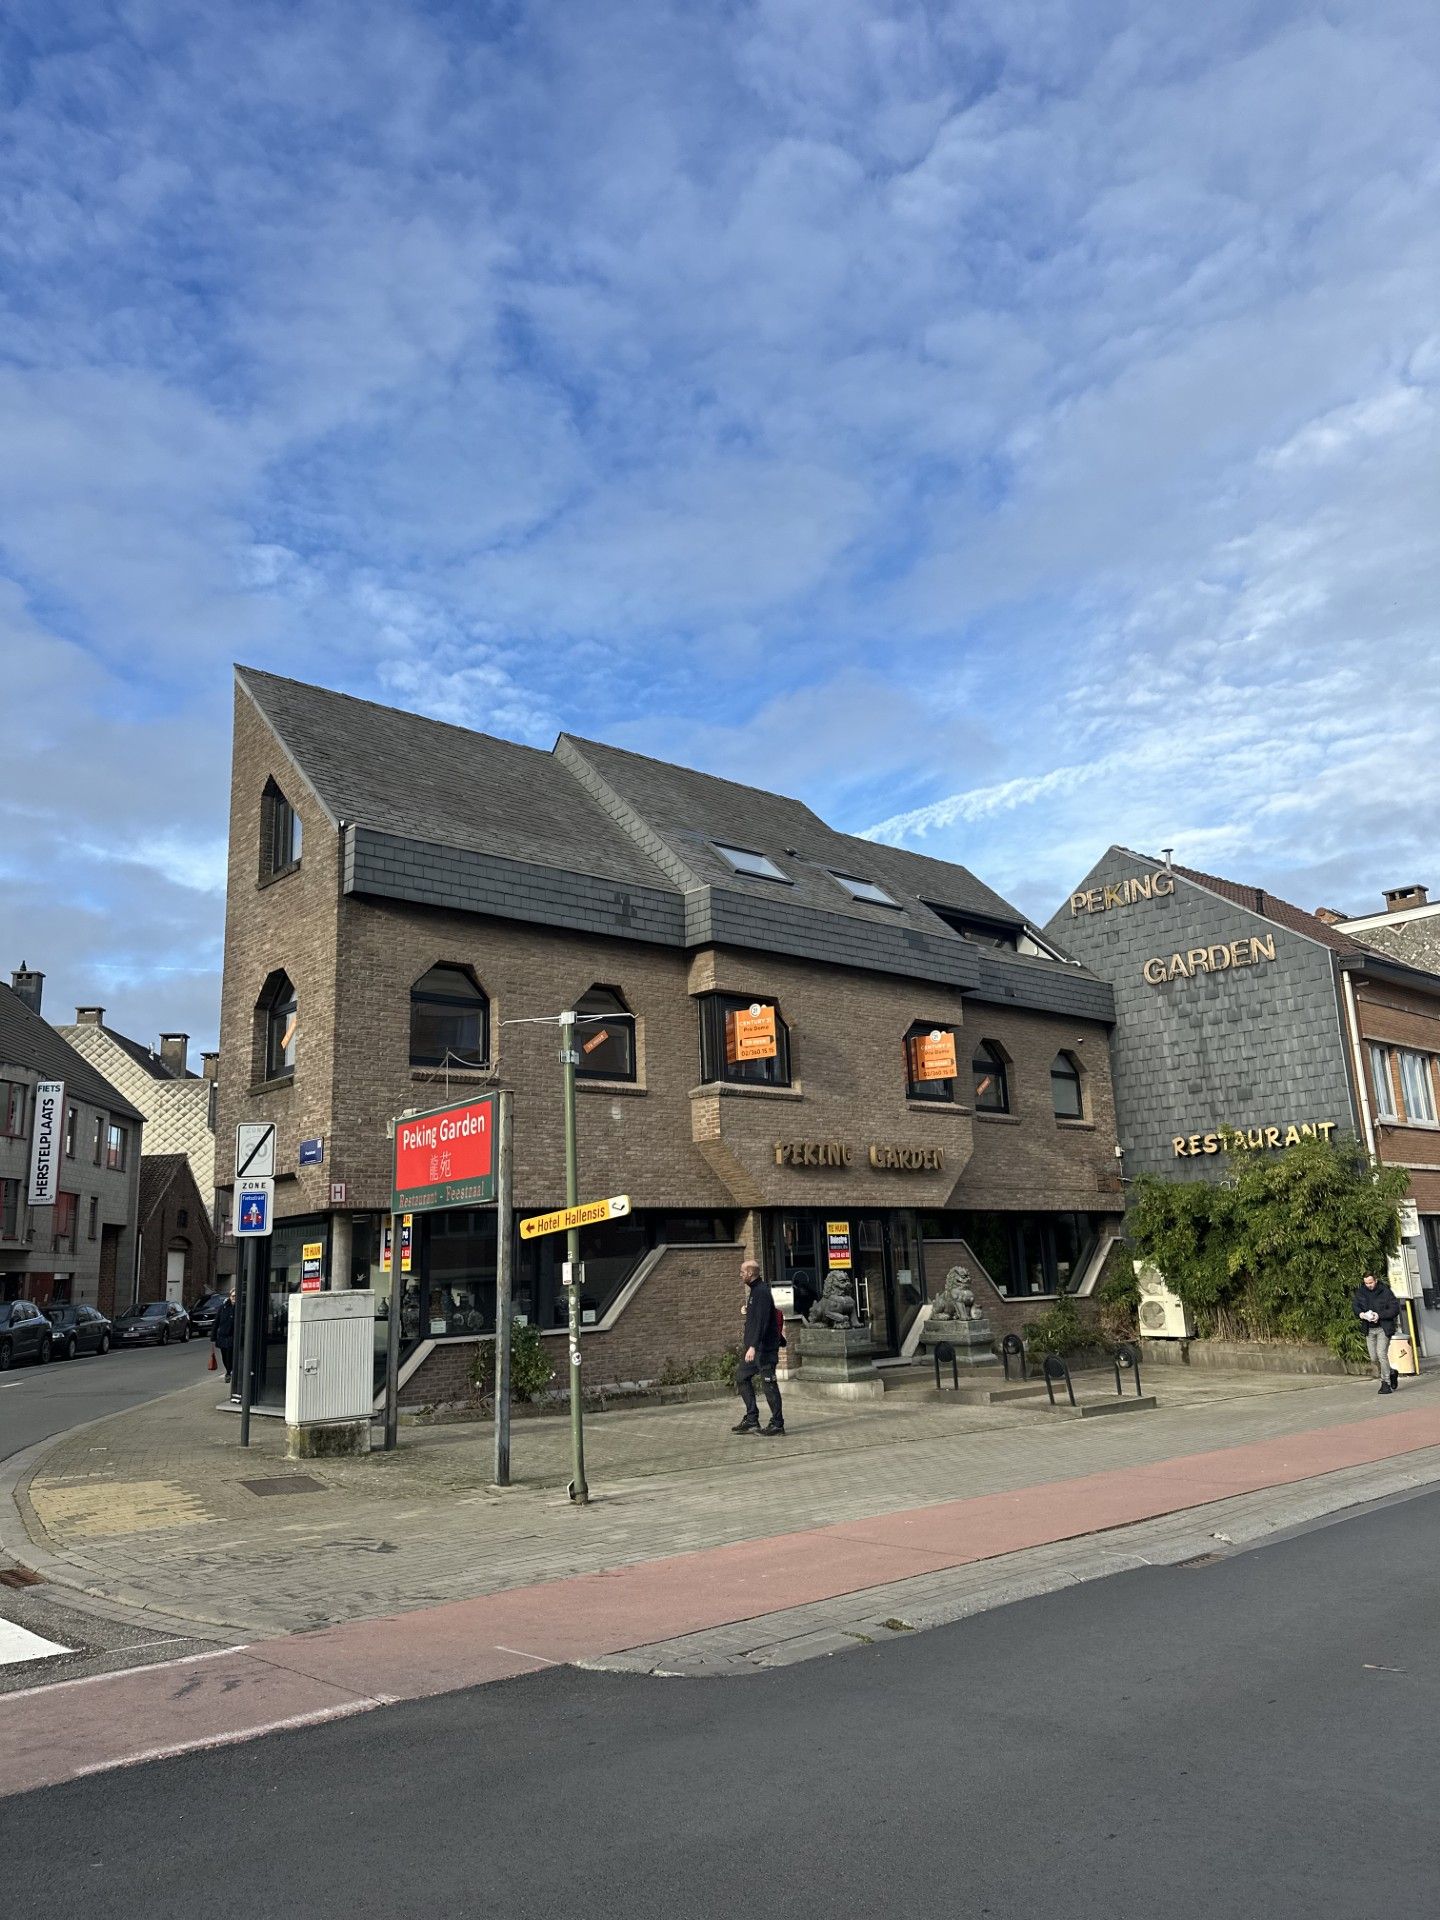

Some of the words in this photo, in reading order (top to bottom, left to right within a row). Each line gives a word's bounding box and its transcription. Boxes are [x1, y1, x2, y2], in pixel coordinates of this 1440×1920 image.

[1069, 869, 1175, 918] PEKING
[1142, 933, 1277, 985] GARDEN
[37, 1084, 61, 1092] FIETS
[403, 1124, 437, 1151] Peking
[439, 1112, 485, 1142] Garden
[1171, 1121, 1338, 1157] RESTAURANT
[35, 1098, 55, 1197] HERSTELPLAATS
[245, 1142, 268, 1158] 30
[775, 1141, 855, 1167] PEKING
[869, 1144, 944, 1170] GARDEN
[332, 1185, 343, 1200] H
[399, 1191, 438, 1209] Restaurant
[446, 1180, 485, 1202] Feestzaal
[537, 1215, 560, 1233] Hotel
[565, 1205, 606, 1226] Hallensis
